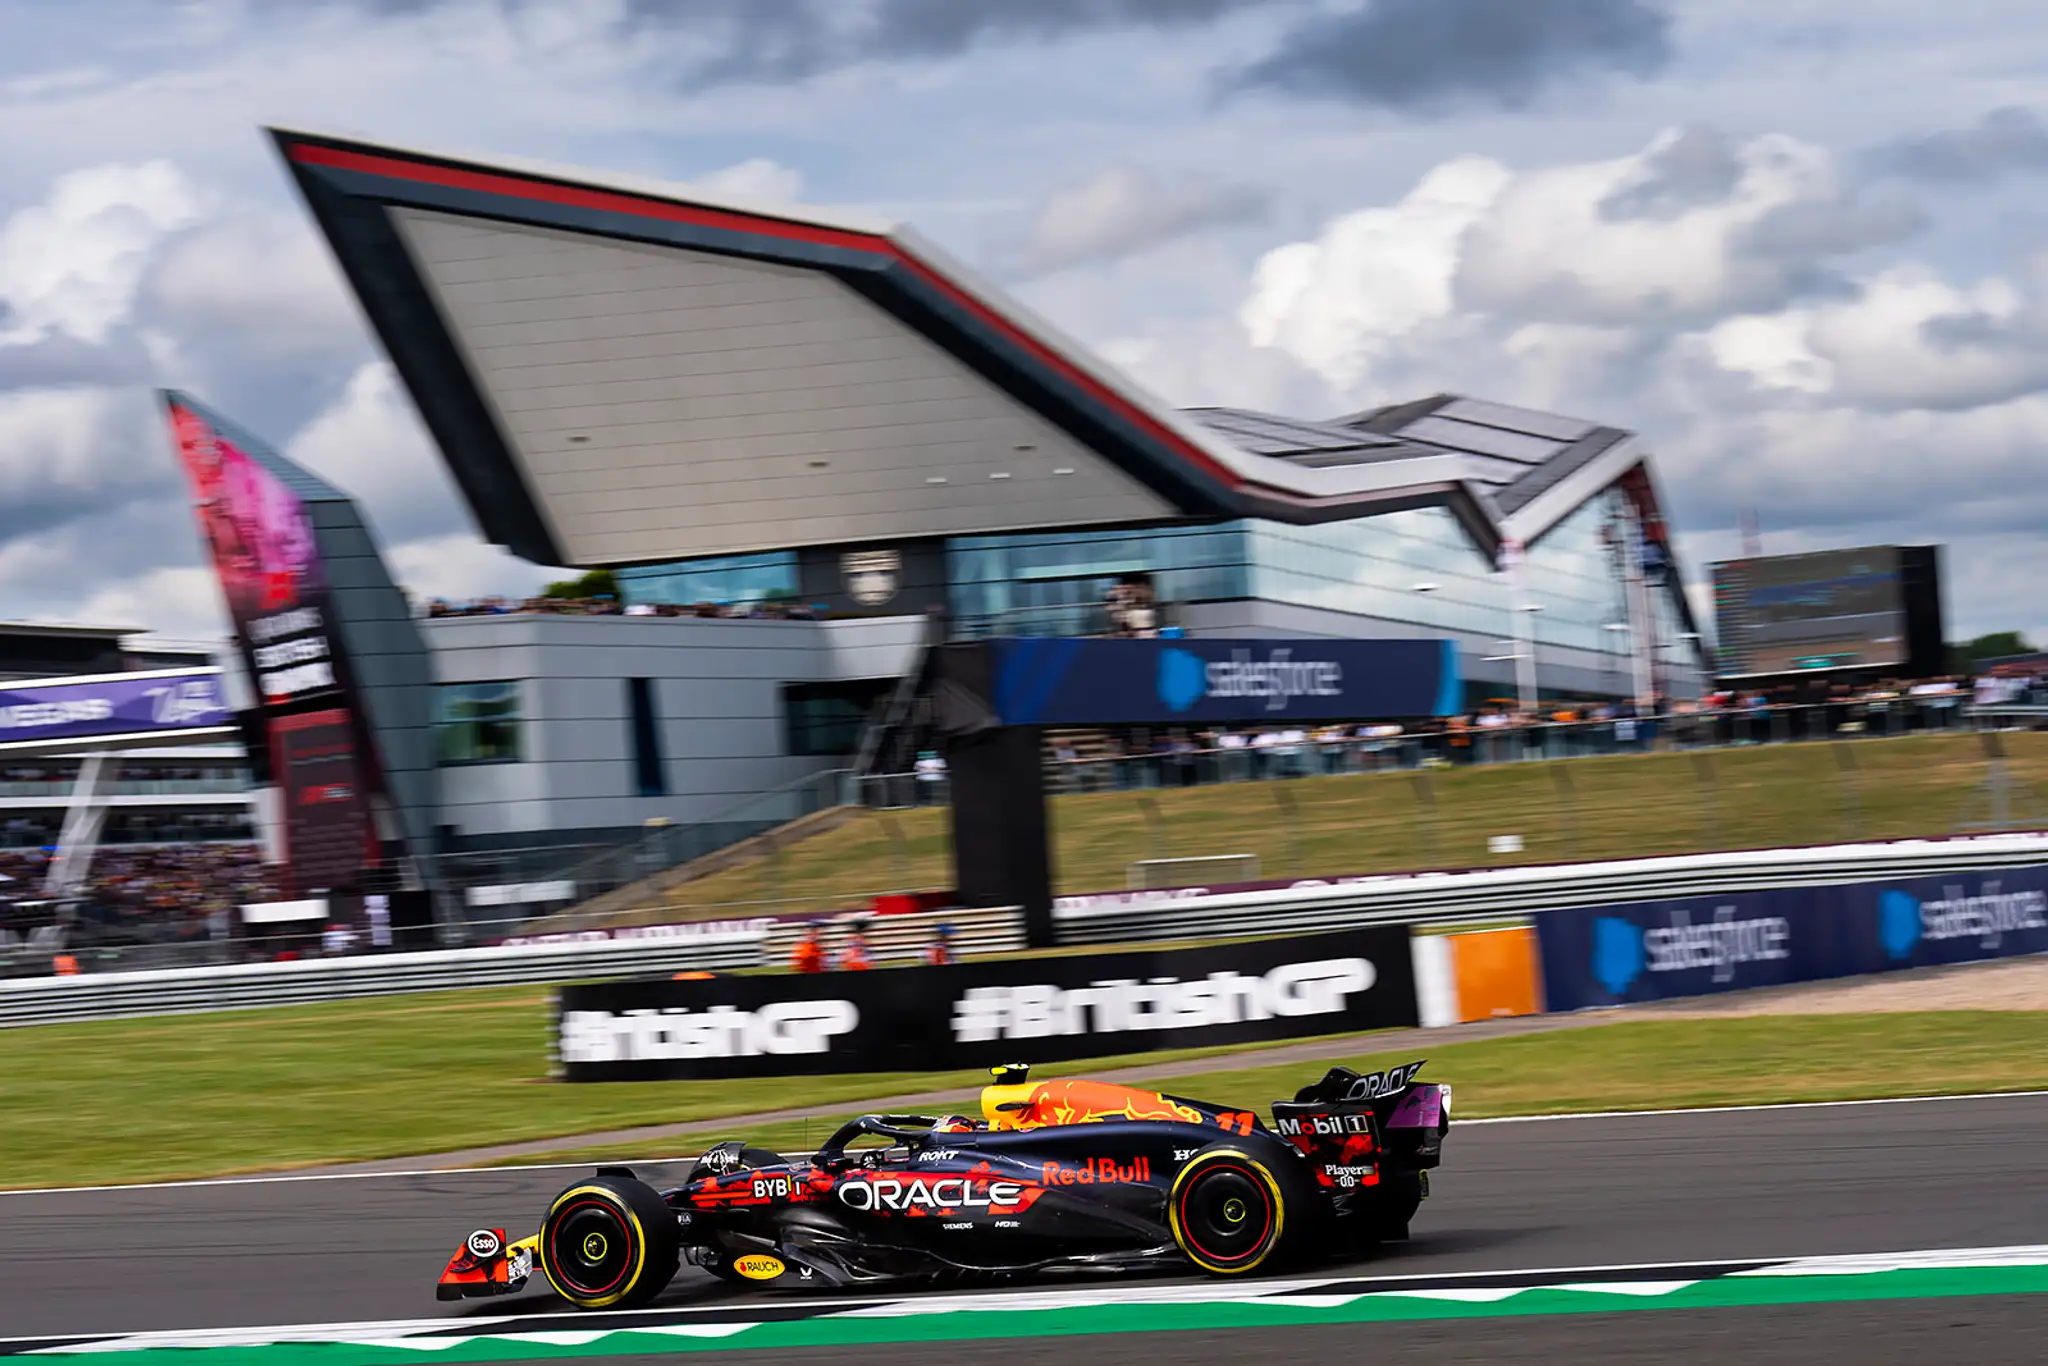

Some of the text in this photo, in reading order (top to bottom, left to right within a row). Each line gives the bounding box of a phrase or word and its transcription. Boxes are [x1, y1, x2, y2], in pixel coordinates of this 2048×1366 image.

[1205, 649, 1343, 710] salesforce
[1645, 906, 1789, 982] salesforce
[1214, 1112, 1255, 1137] 11
[1278, 1115, 1344, 1136] Mobil
[919, 1150, 960, 1162] ROKT
[1043, 1156, 1151, 1187] Red Bull
[1325, 1164, 1363, 1178] Player
[839, 1179, 1022, 1211] ORACLE
[473, 1236, 495, 1250] Esso
[748, 1262, 779, 1272] RAUCH
